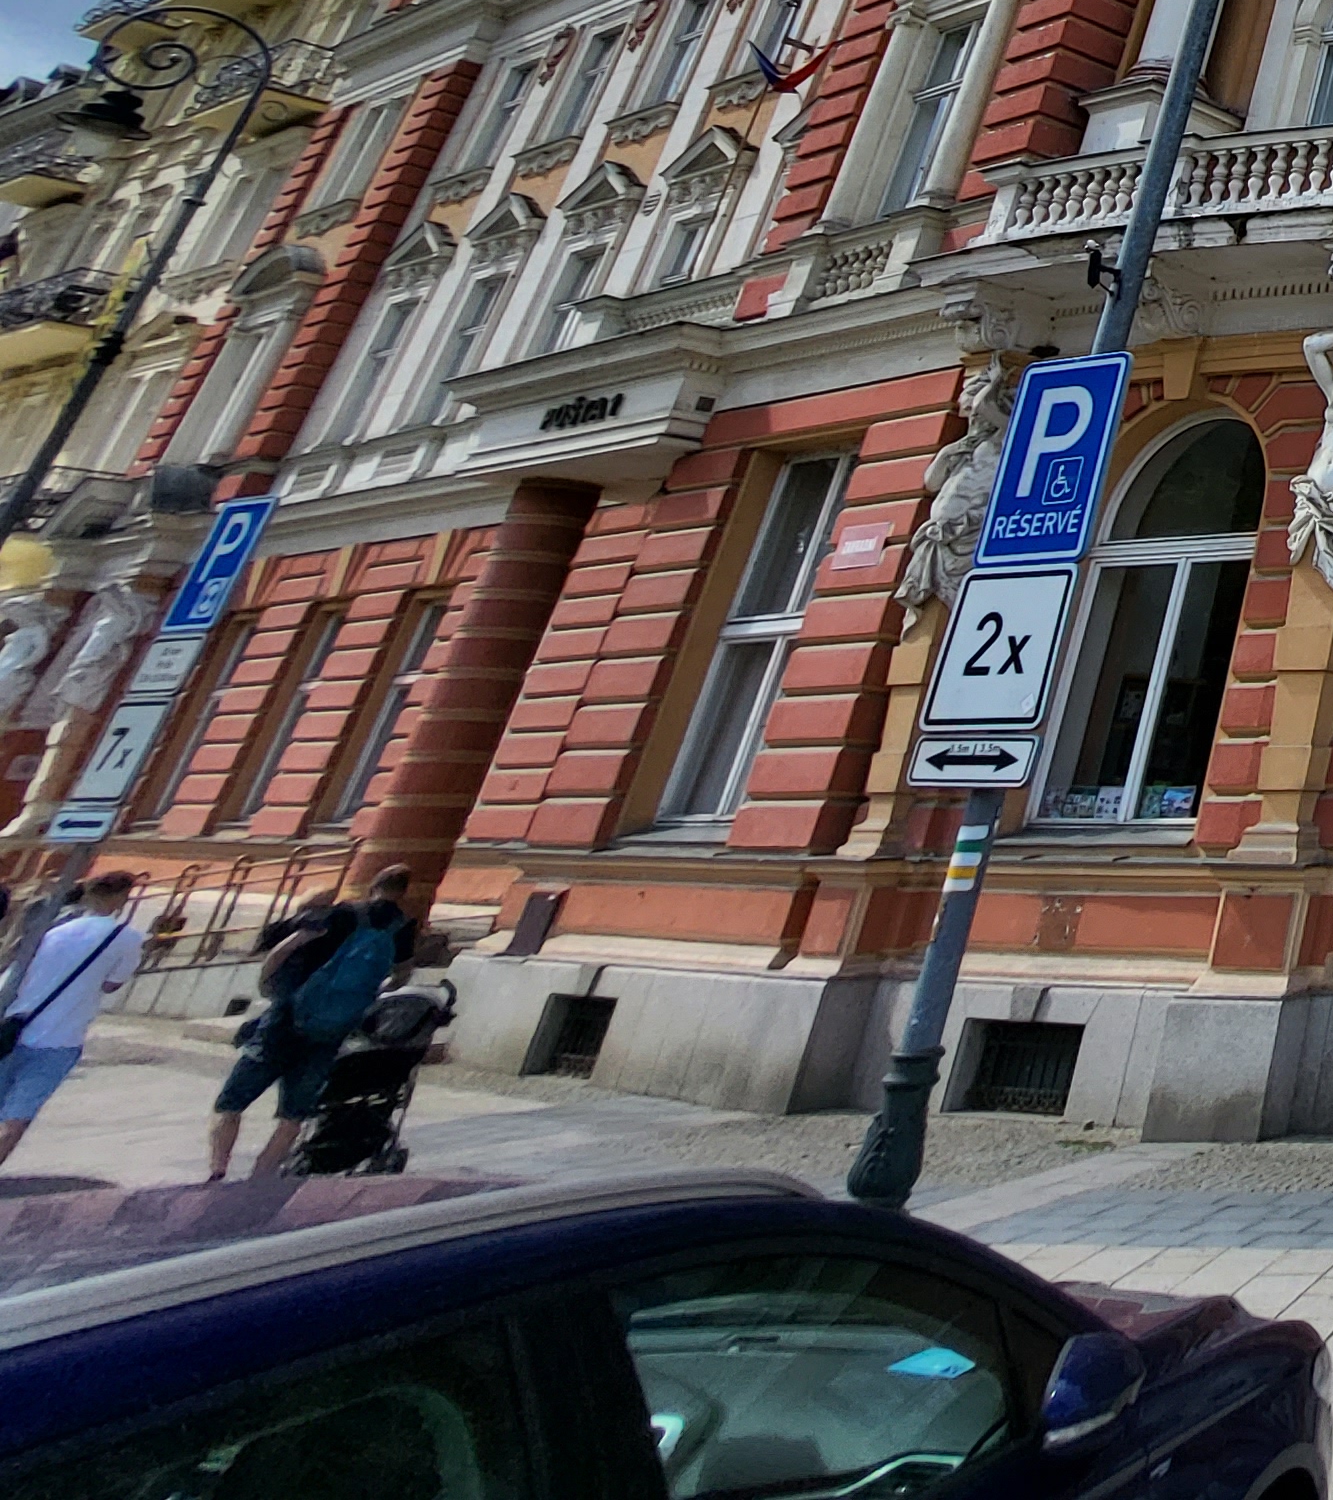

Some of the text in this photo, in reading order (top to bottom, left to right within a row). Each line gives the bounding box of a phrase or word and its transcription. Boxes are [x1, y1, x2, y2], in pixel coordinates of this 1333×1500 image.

[1015, 385, 1093, 498] P
[199, 512, 253, 584] P
[991, 504, 1083, 540] RÉSERVÉ
[962, 611, 1032, 676] 2x
[96, 727, 134, 772] 7x
